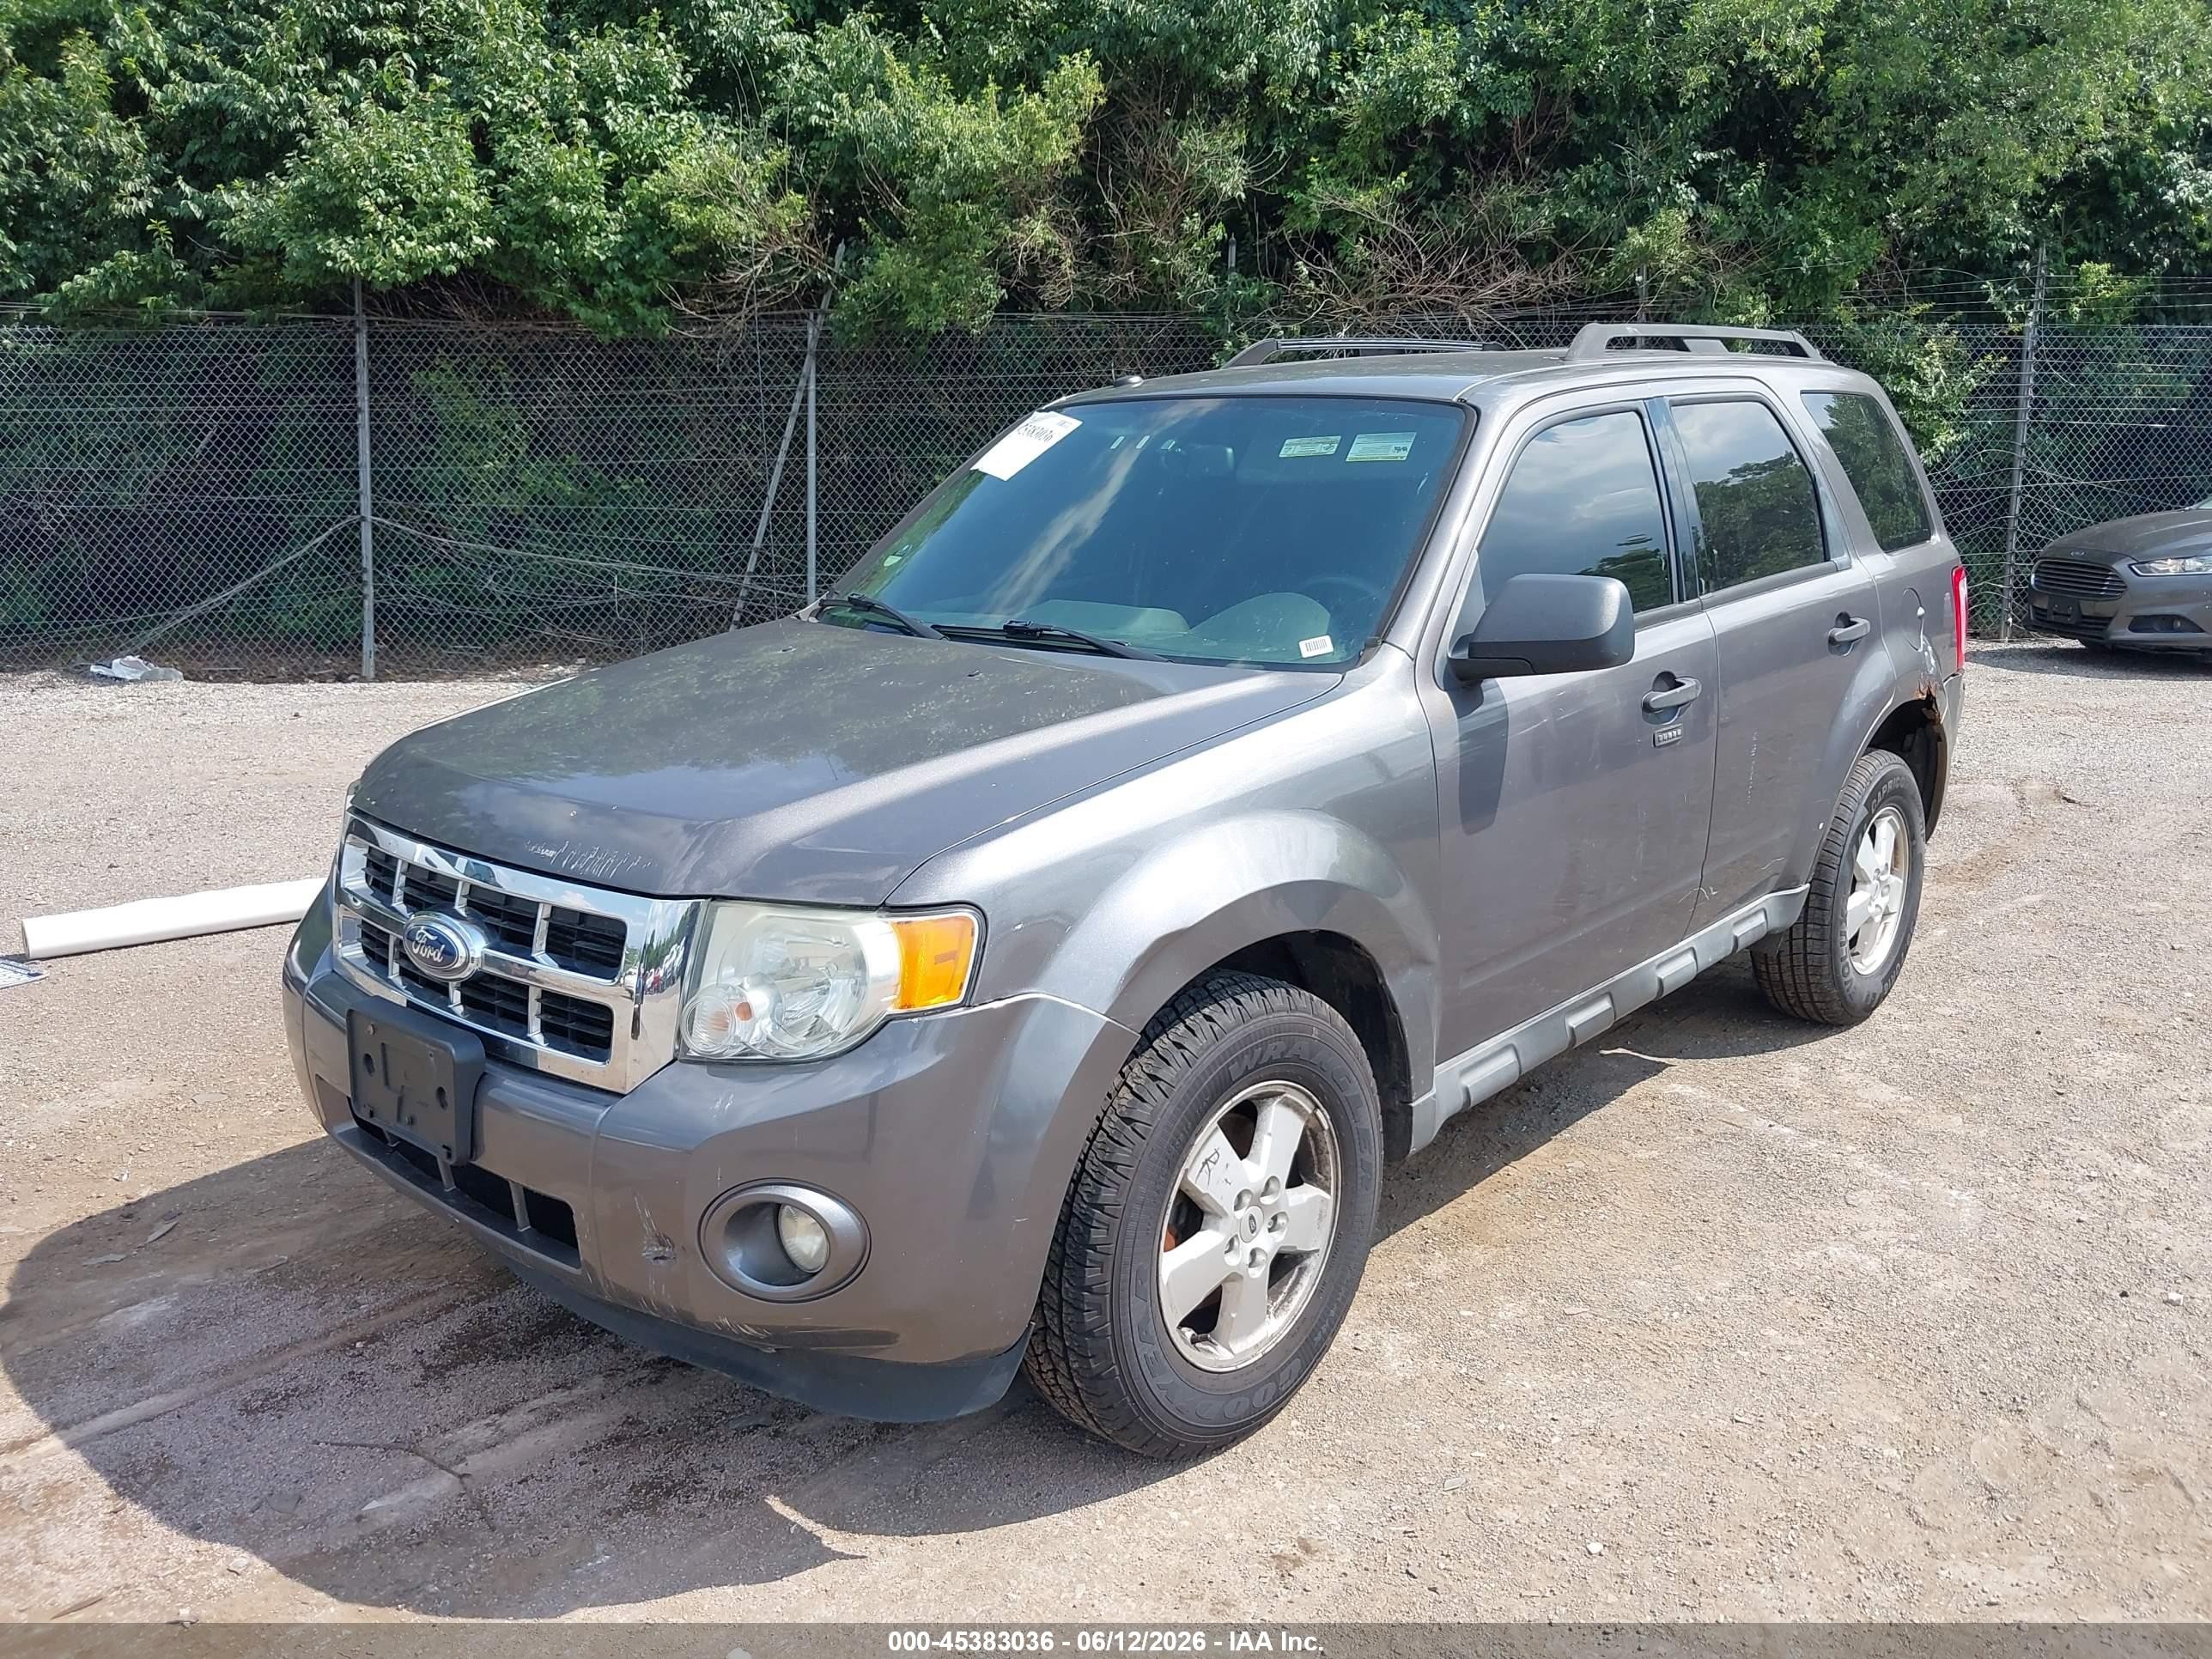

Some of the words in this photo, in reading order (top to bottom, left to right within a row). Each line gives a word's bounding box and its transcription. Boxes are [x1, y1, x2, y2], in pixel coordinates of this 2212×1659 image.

[411, 927, 445, 963] Ford
[1229, 1040, 1375, 1191] WRANGLER
[1134, 1267, 1304, 1421] GOODYEAR
